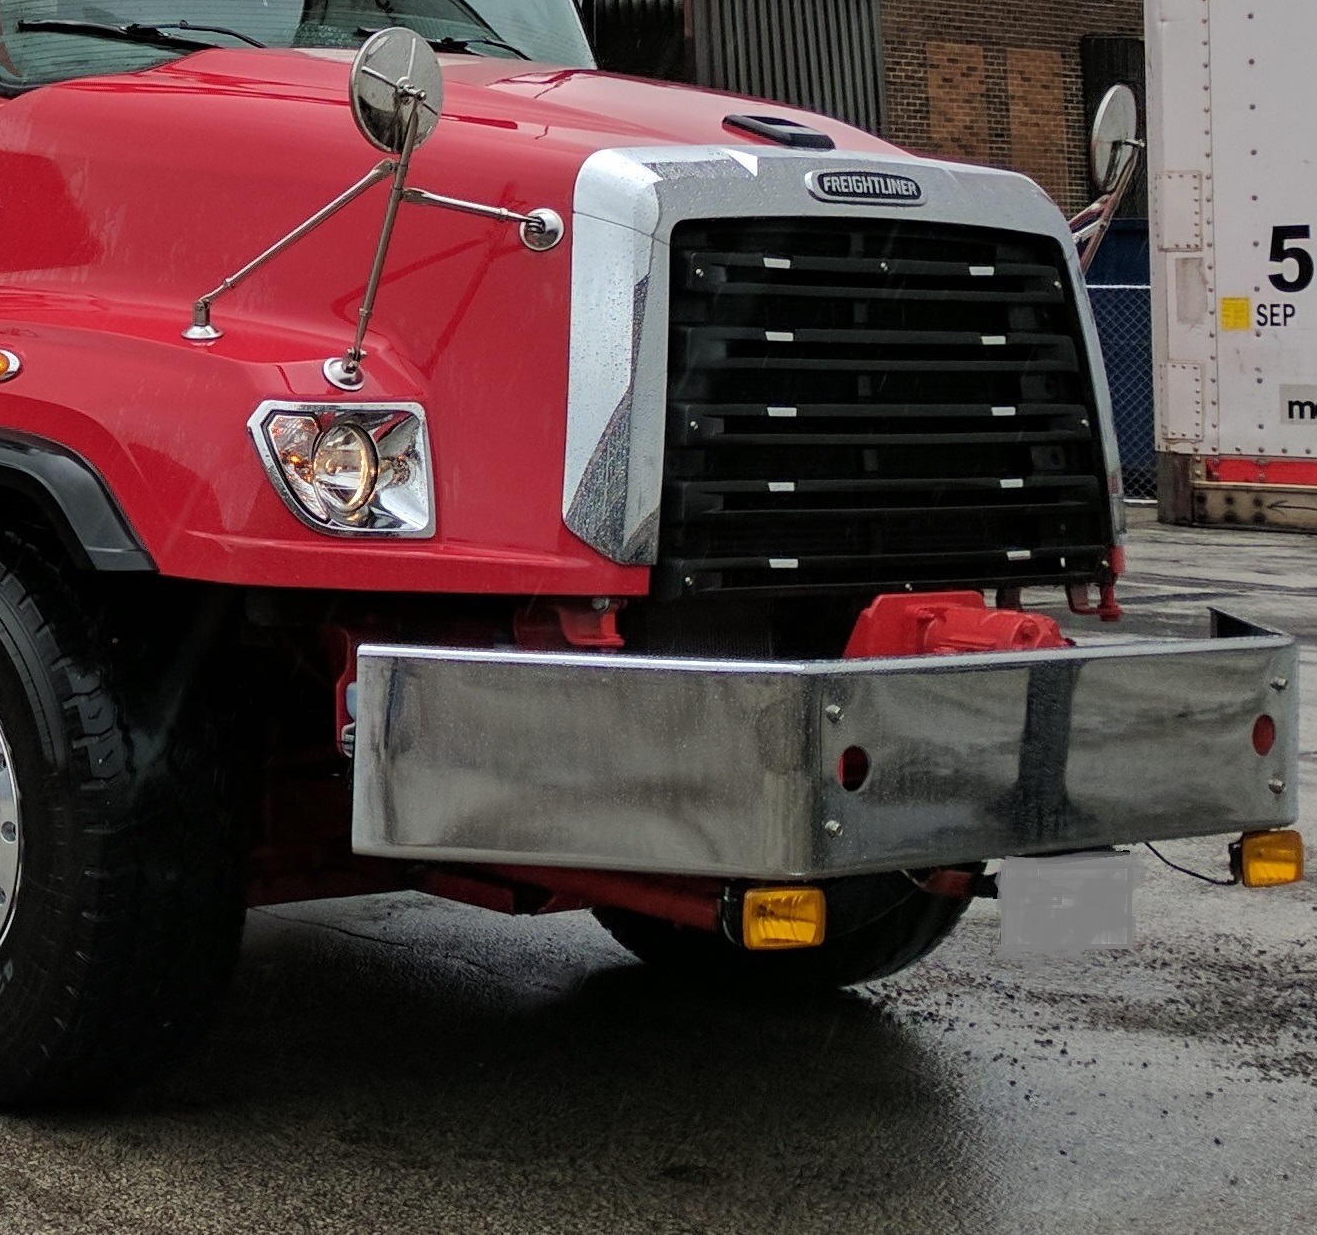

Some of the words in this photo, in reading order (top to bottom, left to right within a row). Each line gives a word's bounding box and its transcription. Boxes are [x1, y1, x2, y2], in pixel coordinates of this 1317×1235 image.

[822, 175, 919, 196] FREIGHTLINER
[1267, 224, 1314, 293] 5
[1256, 303, 1296, 327] SEP
[1288, 399, 1317, 420] m
